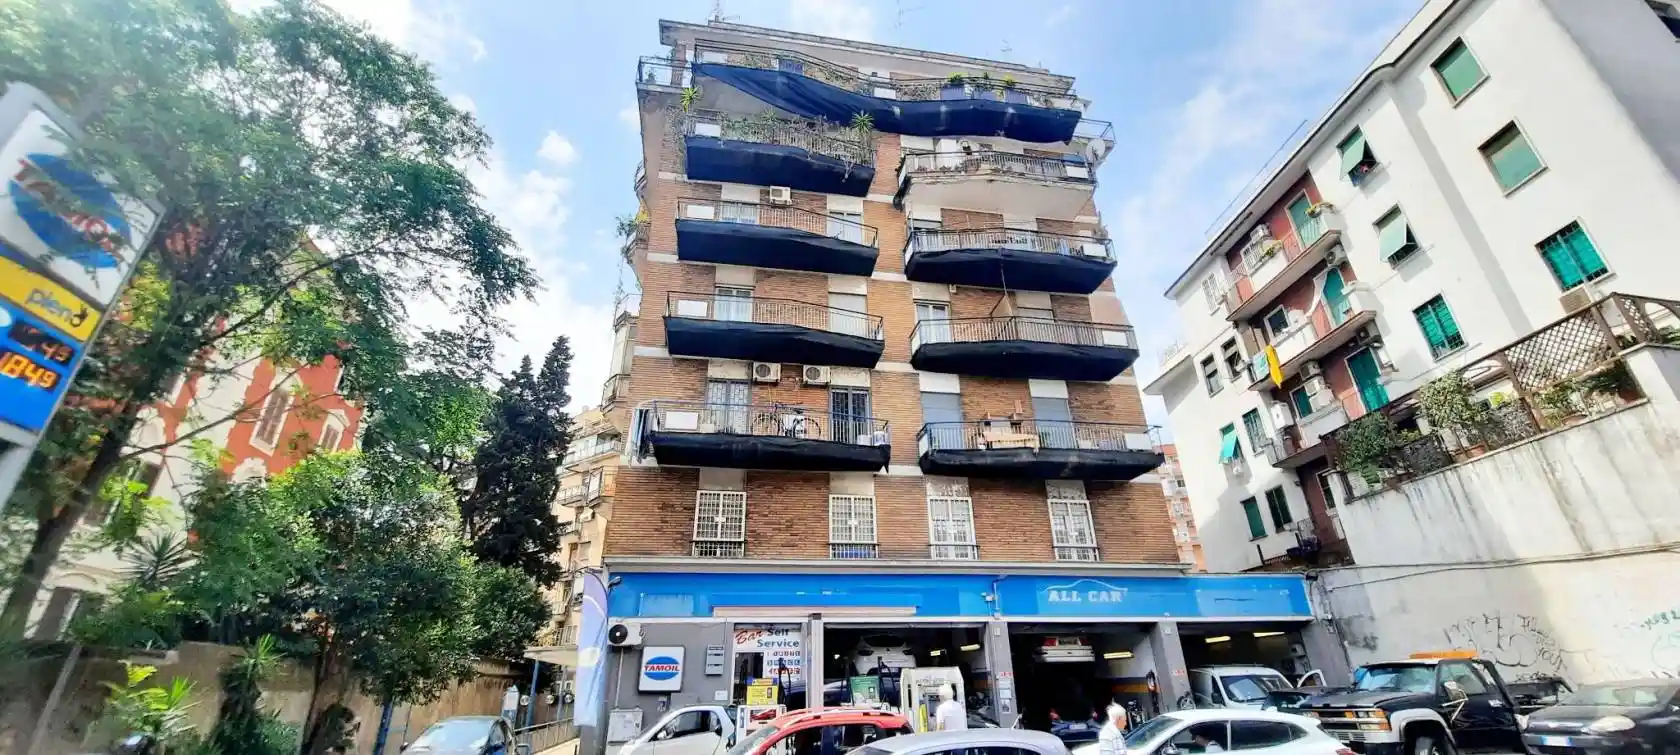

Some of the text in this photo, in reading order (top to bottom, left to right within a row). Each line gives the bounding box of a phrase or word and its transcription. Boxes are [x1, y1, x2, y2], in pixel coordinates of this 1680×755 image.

[1048, 591, 1123, 602] ALL CAR
[735, 630, 763, 645] Bar
[767, 628, 789, 637] Self
[757, 639, 800, 648] Service
